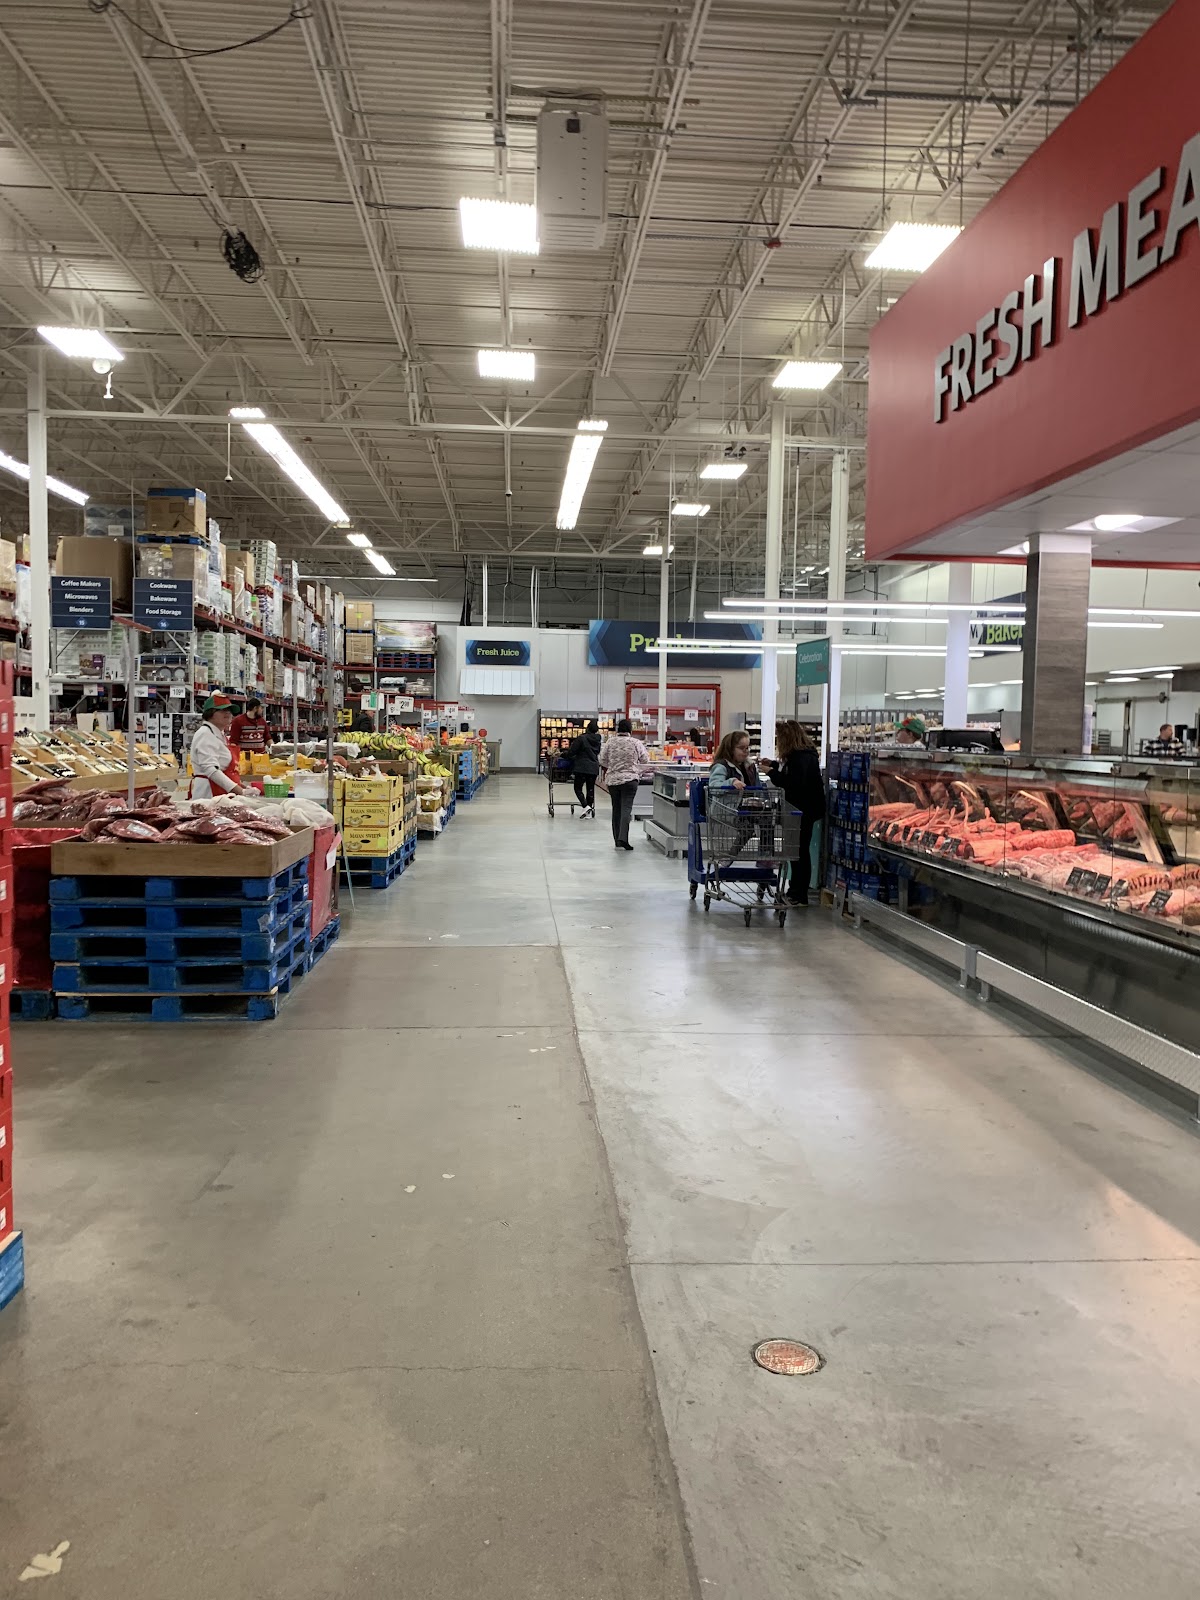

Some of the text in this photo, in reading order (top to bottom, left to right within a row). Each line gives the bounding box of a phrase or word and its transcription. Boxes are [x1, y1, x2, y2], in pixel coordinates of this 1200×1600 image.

[933, 256, 1056, 423] FRESH
[80, 580, 101, 588] Makers
[476, 648, 520, 656] Fresh Juice
